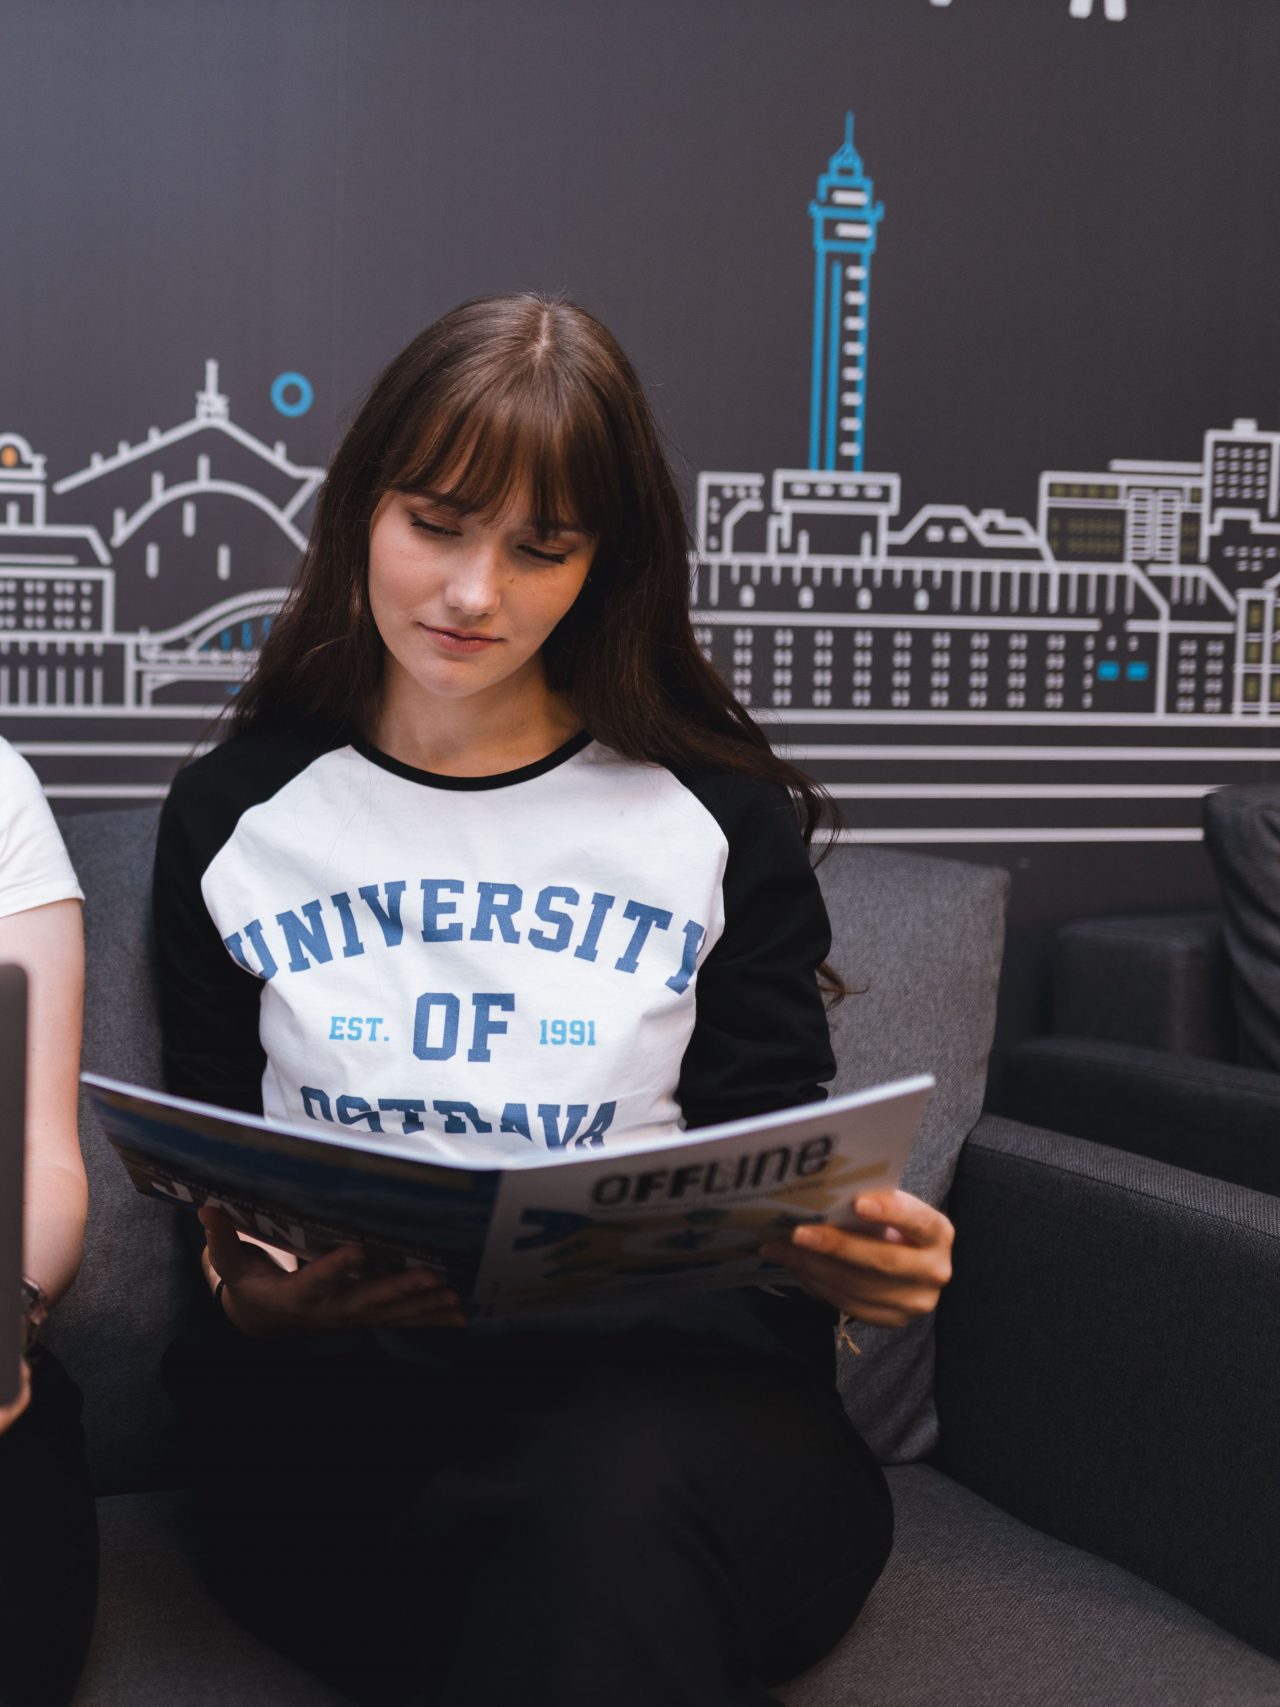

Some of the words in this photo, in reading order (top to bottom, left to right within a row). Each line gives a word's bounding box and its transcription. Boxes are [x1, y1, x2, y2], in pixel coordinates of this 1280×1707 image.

[223, 879, 705, 995] UNIVERSITY
[329, 1016, 390, 1042] EST.
[413, 992, 515, 1062] OF
[539, 1019, 596, 1046] 1991
